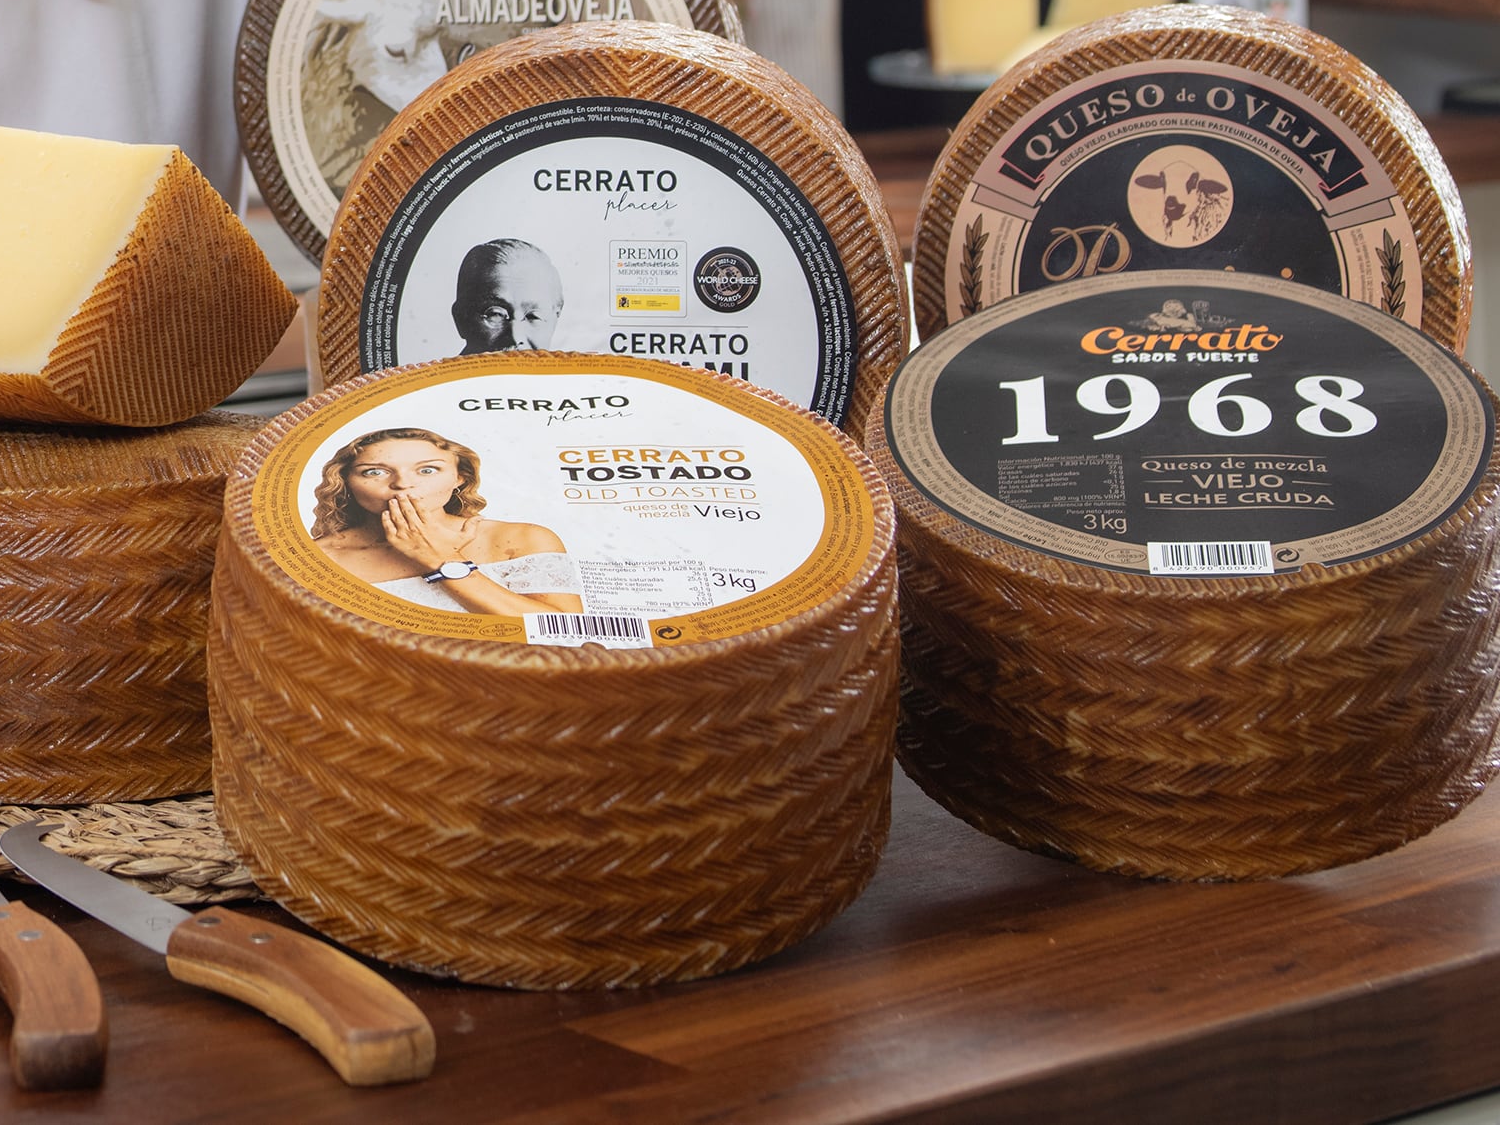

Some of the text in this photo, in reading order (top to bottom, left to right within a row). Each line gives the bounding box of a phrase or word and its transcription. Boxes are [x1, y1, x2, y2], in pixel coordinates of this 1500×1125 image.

[537, 106, 575, 120] comestible.
[576, 105, 585, 113] En
[586, 104, 612, 112] corteza:
[614, 104, 661, 119] conservadores
[503, 116, 529, 132] Corteza
[528, 113, 538, 122] no
[705, 128, 711, 136] y
[1024, 83, 1340, 174] QUESO de OVEJA
[710, 130, 739, 151] colorante
[1084, 134, 1107, 149] VIEJO
[1108, 119, 1158, 138] ELABORADO
[1159, 118, 1178, 126] CON
[1180, 118, 1206, 127] LECHE
[1208, 121, 1269, 149] PASTEURIZADA
[1269, 145, 1281, 156] DE
[1280, 152, 1305, 175] OVEJA
[449, 140, 480, 165] fermentos
[737, 146, 759, 166] E-160b
[533, 169, 678, 193] CERRATO
[735, 168, 758, 189] Quesos
[765, 169, 785, 189] Origen
[755, 185, 777, 208] Cerrato
[781, 186, 792, 196] de
[787, 193, 797, 202] la
[603, 191, 678, 221] placer
[773, 205, 782, 215] S.
[792, 199, 810, 219] leche:
[426, 188, 438, 201] and
[434, 175, 450, 192] lactic
[446, 156, 472, 180] ferments.
[501, 132, 514, 143] Lait
[513, 121, 544, 138] pasteurisé
[543, 119, 552, 128] de
[552, 115, 570, 126] vache
[610, 113, 629, 122] brebis
[829, 298, 840, 326] ferments
[778, 212, 795, 231] Coop.
[804, 217, 824, 242] España.
[792, 234, 807, 252] Avda.
[618, 247, 679, 260] PREMIO
[802, 251, 816, 272] Pedro
[818, 241, 838, 272] Consumir
[636, 276, 659, 285] 2021
[697, 275, 759, 286] WORLD CHEESE
[810, 271, 827, 305] Cabezudo,
[712, 293, 742, 303] AWARDS
[832, 277, 849, 317] temperatura
[367, 302, 376, 325] cloruro
[384, 314, 392, 337] coloring
[822, 323, 832, 343] 34240
[841, 317, 852, 349] ambiente.
[609, 332, 749, 356] CERRATO
[1080, 323, 1284, 355] Cerrato
[823, 344, 832, 373] Baltanás
[1111, 352, 1260, 364] SABOR FUERTE
[841, 351, 851, 384] Conservar
[840, 385, 848, 394] en
[457, 394, 631, 412] CERRATO
[836, 394, 847, 412] lugar
[999, 372, 1378, 446] 1968
[546, 410, 634, 427] placer
[558, 448, 746, 464] CERRATO
[560, 465, 752, 482] TOSTADO
[1141, 457, 1328, 474] Queso de mezcla
[1191, 474, 1284, 490] VIEJO
[563, 486, 757, 500] OLD TOASTED
[1144, 490, 1335, 506] LECHE CRUDA
[623, 503, 689, 514] queso de
[638, 510, 691, 519] mezcla
[693, 504, 761, 522] Viejo
